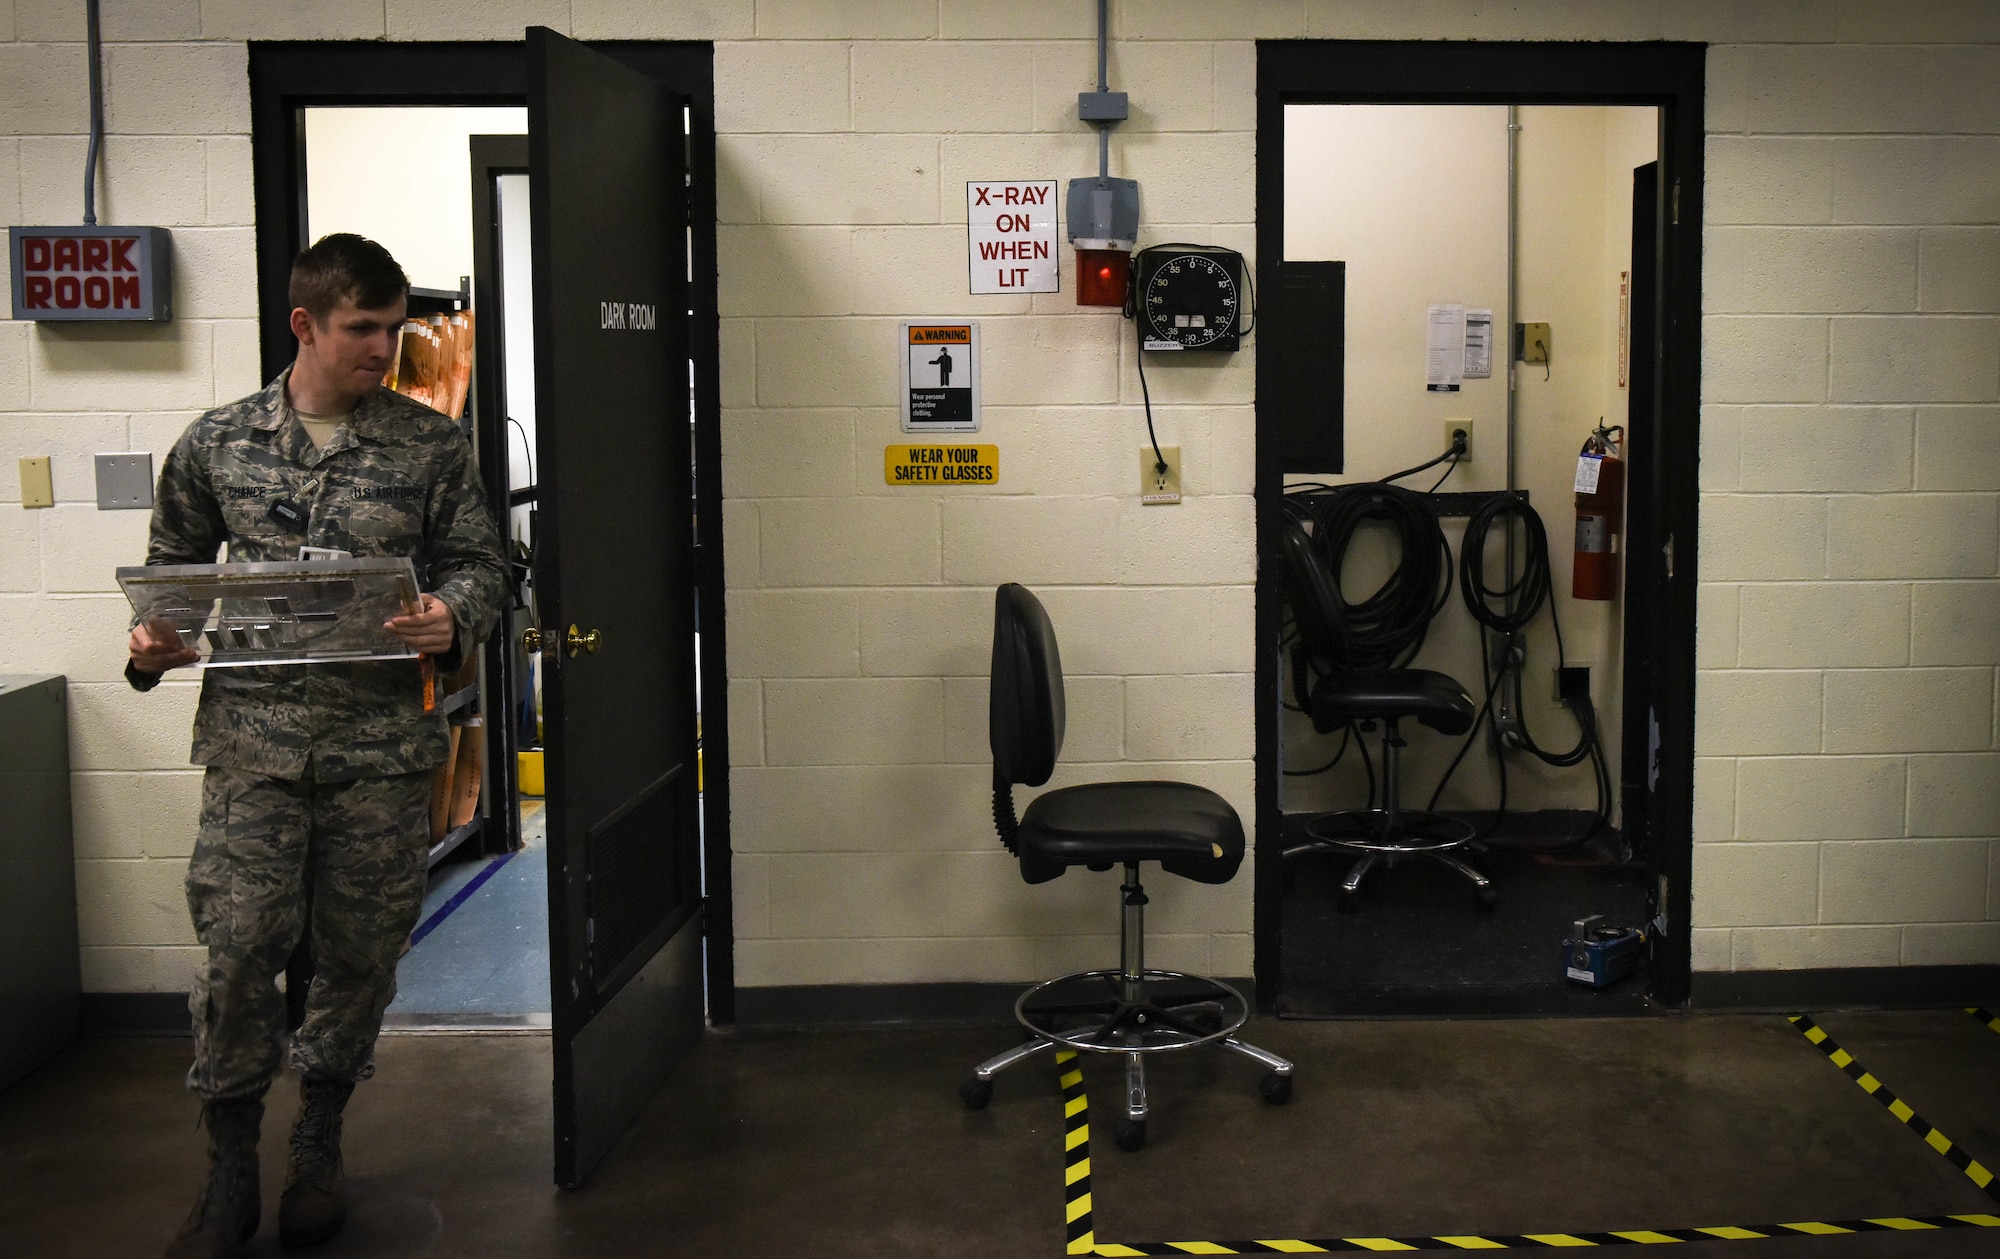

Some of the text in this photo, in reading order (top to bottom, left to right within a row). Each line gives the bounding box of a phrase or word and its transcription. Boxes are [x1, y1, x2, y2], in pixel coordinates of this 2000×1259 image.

[975, 186, 1049, 206] X-RAY
[996, 214, 1030, 233] ON
[24, 239, 138, 272] DARK
[978, 240, 1048, 260] WHEN
[999, 268, 1029, 287] LIT
[25, 276, 141, 310] ROOM
[601, 301, 655, 330] DARK ROOM
[1215, 316, 1226, 324] 20
[925, 330, 967, 340] WARNING
[1168, 327, 1179, 335] 35
[925, 393, 946, 401] personal
[909, 449, 978, 463] WEAR YOUR
[895, 465, 993, 480] SAFETY GLASSES
[228, 486, 267, 499] CHANCE
[376, 487, 393, 499] AIR
[395, 487, 425, 499] FORCE
